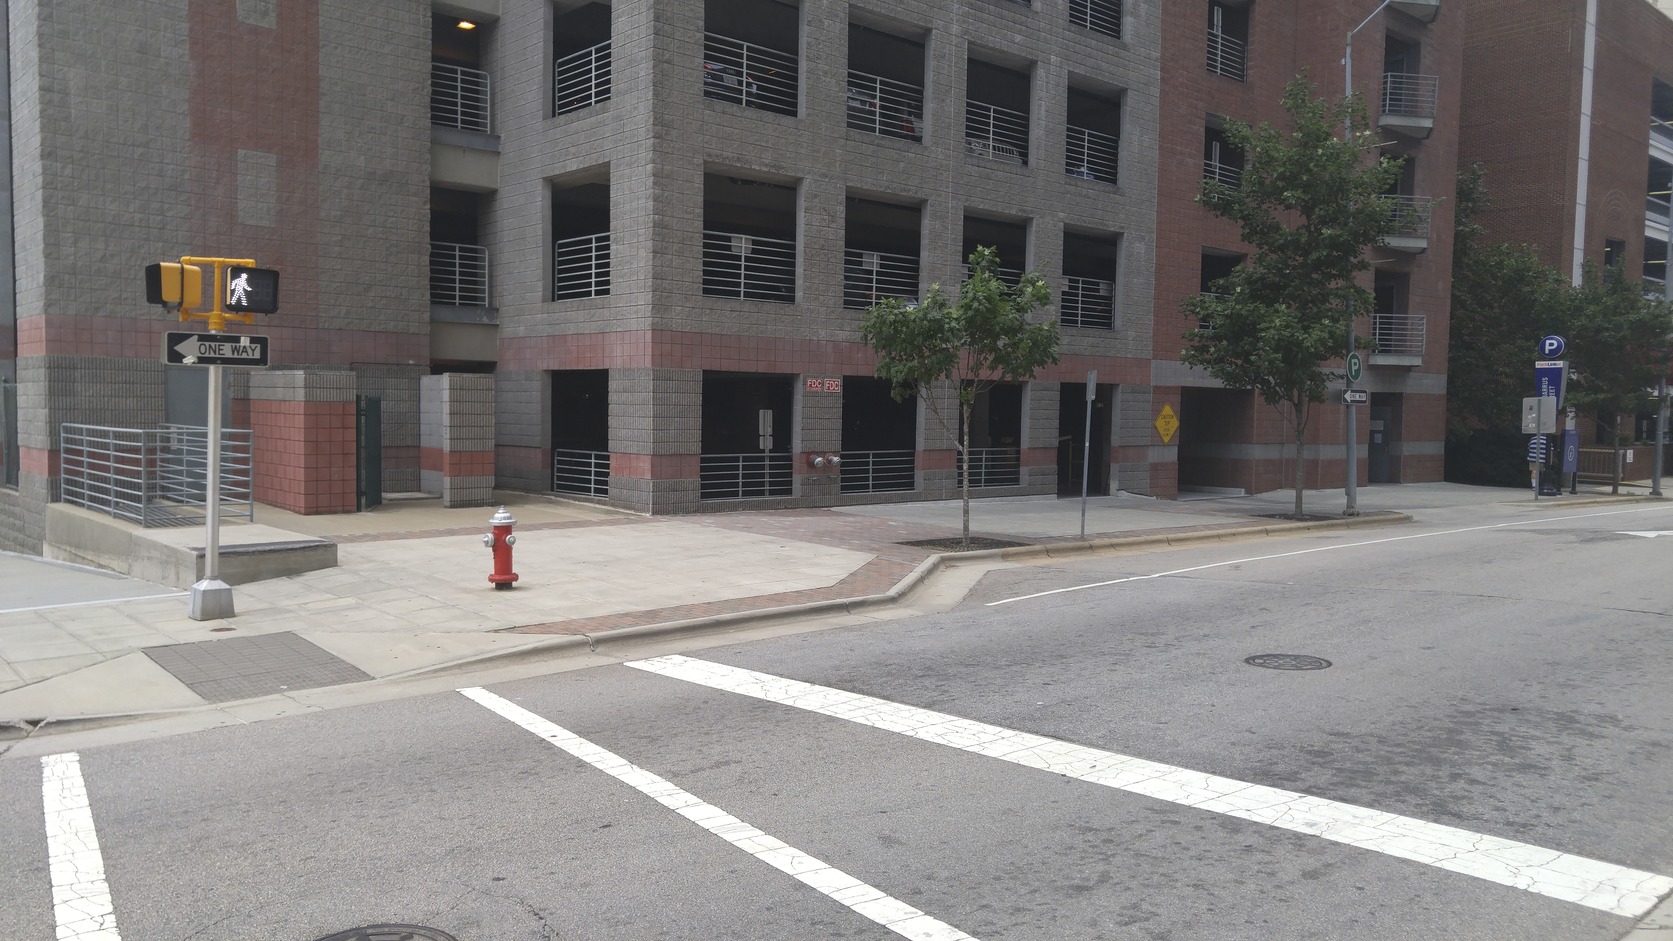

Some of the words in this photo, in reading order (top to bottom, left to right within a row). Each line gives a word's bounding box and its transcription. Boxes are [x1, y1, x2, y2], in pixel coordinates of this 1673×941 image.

[198, 343, 226, 356] ONE
[230, 344, 258, 357] WAY
[1544, 339, 1558, 354] P
[1351, 358, 1359, 376] P
[807, 379, 822, 388] FDC
[825, 380, 839, 390] FDC
